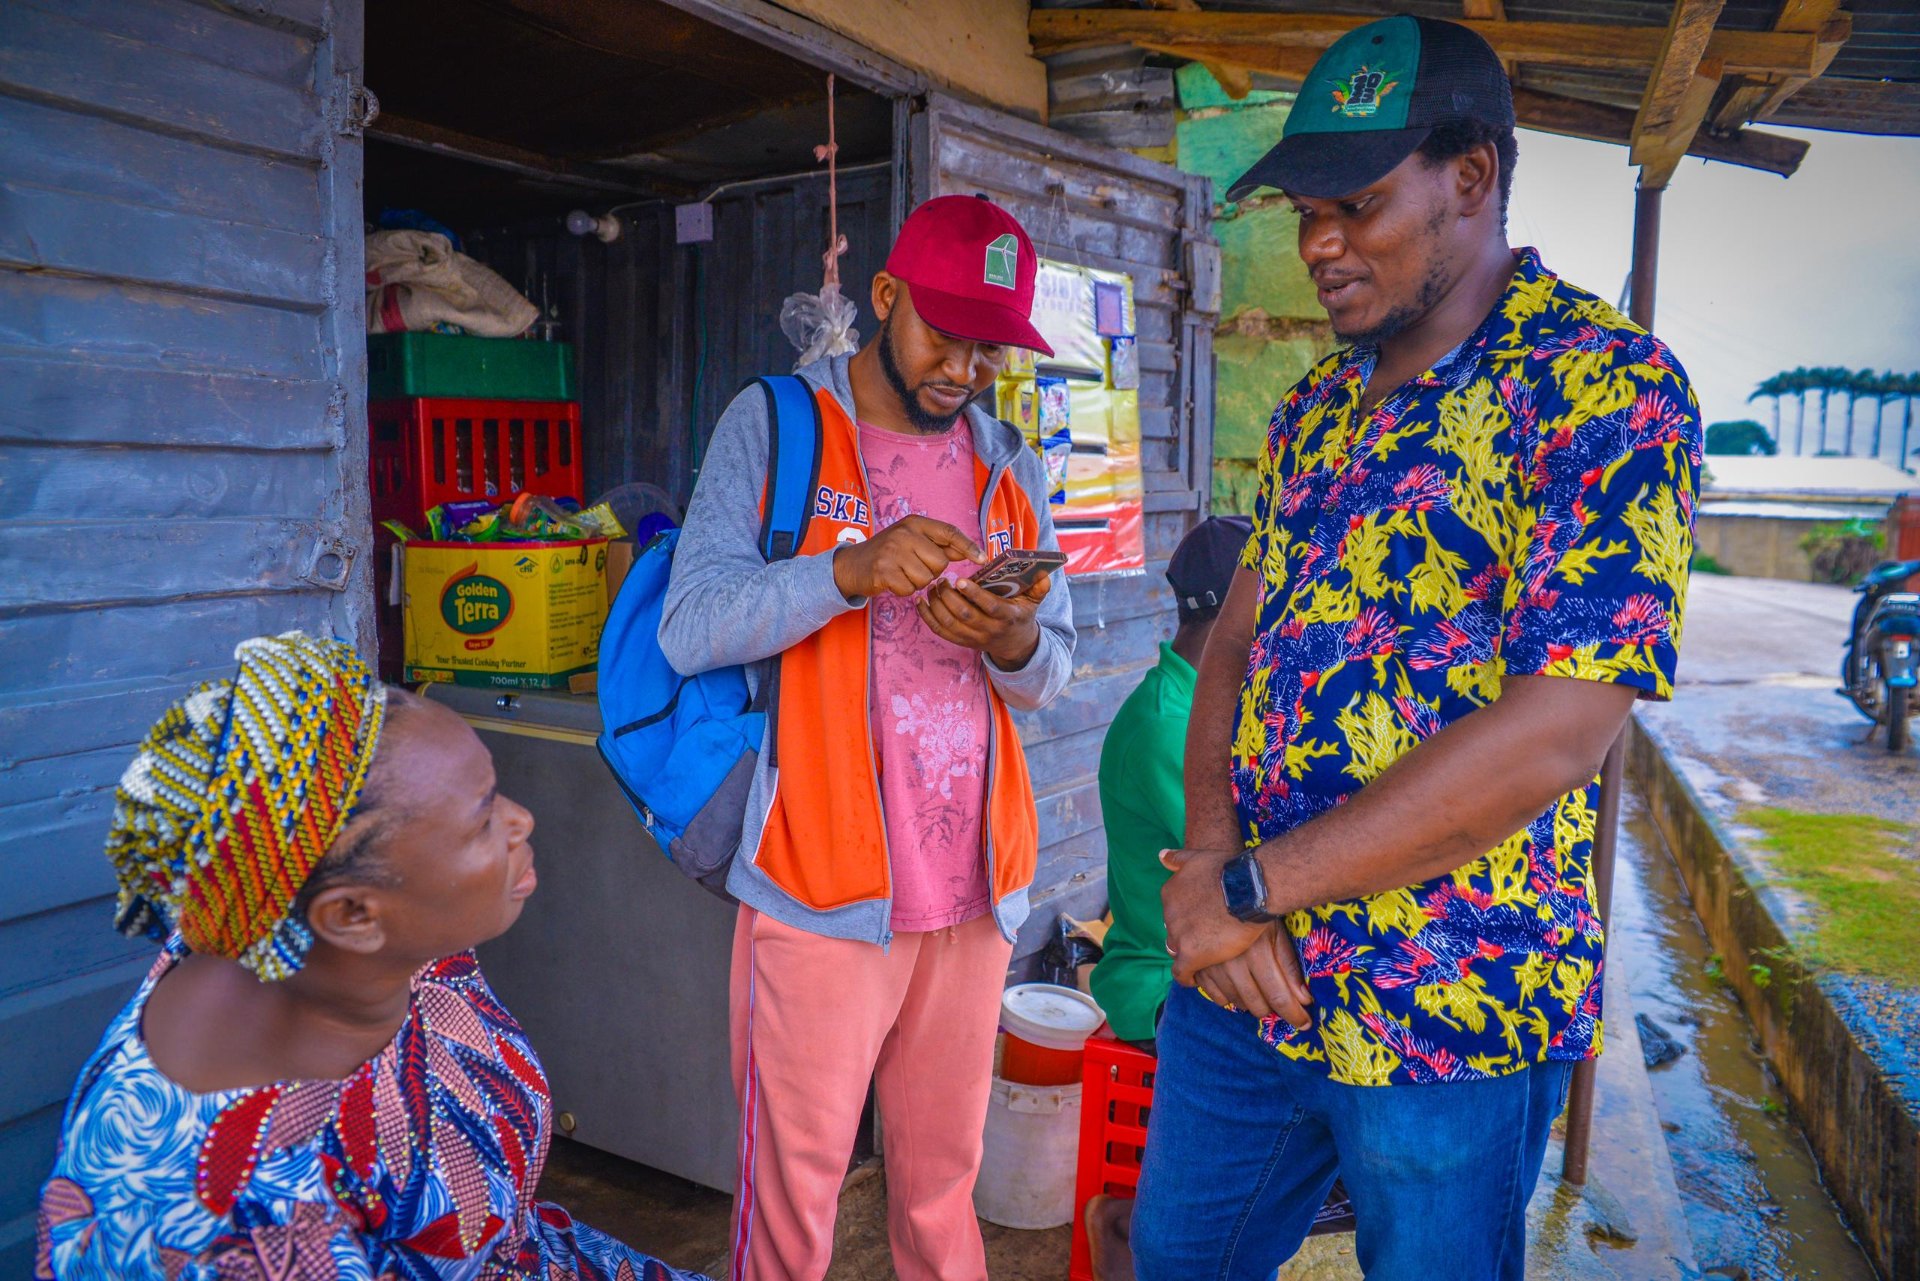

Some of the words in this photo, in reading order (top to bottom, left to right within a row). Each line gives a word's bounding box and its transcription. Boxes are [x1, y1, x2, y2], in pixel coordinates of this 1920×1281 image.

[456, 582, 498, 598] Golden
[454, 597, 499, 626] Terra
[435, 655, 450, 664] Your
[451, 655, 474, 666] Trusted
[475, 656, 500, 669] Cooking
[501, 657, 526, 668] Partner
[490, 675, 519, 686] 700ml
